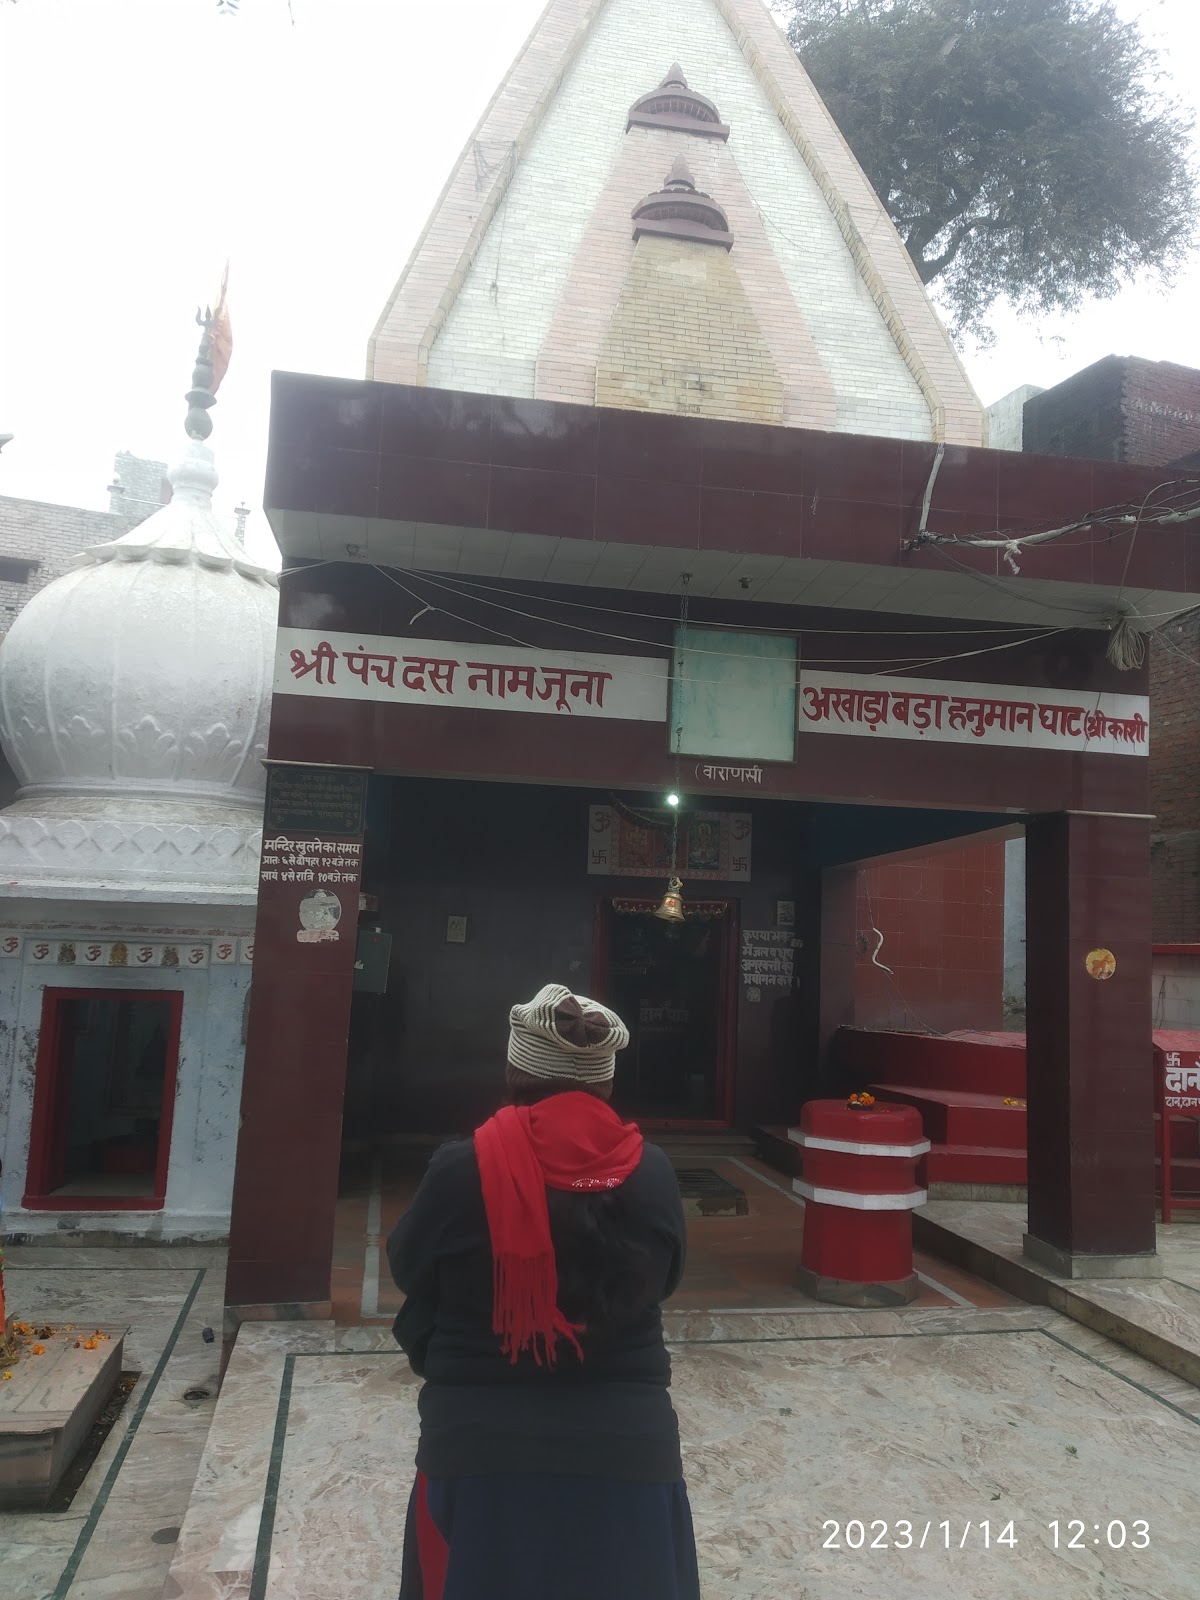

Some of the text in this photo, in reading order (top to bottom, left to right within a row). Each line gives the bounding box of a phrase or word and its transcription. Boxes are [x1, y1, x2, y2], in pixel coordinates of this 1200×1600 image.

[290, 641, 613, 713] श्री पंच दस नाम जूना
[802, 686, 891, 731] अखाड़ा
[890, 691, 949, 735] बड़ा
[948, 697, 1037, 737] हनुमान
[1037, 703, 1086, 737] घाट
[264, 836, 294, 852] मन्दिर
[296, 838, 322, 854] खुलने
[337, 843, 362, 854] समय
[261, 869, 279, 881] सायं
[296, 869, 315, 882] रात्रि
